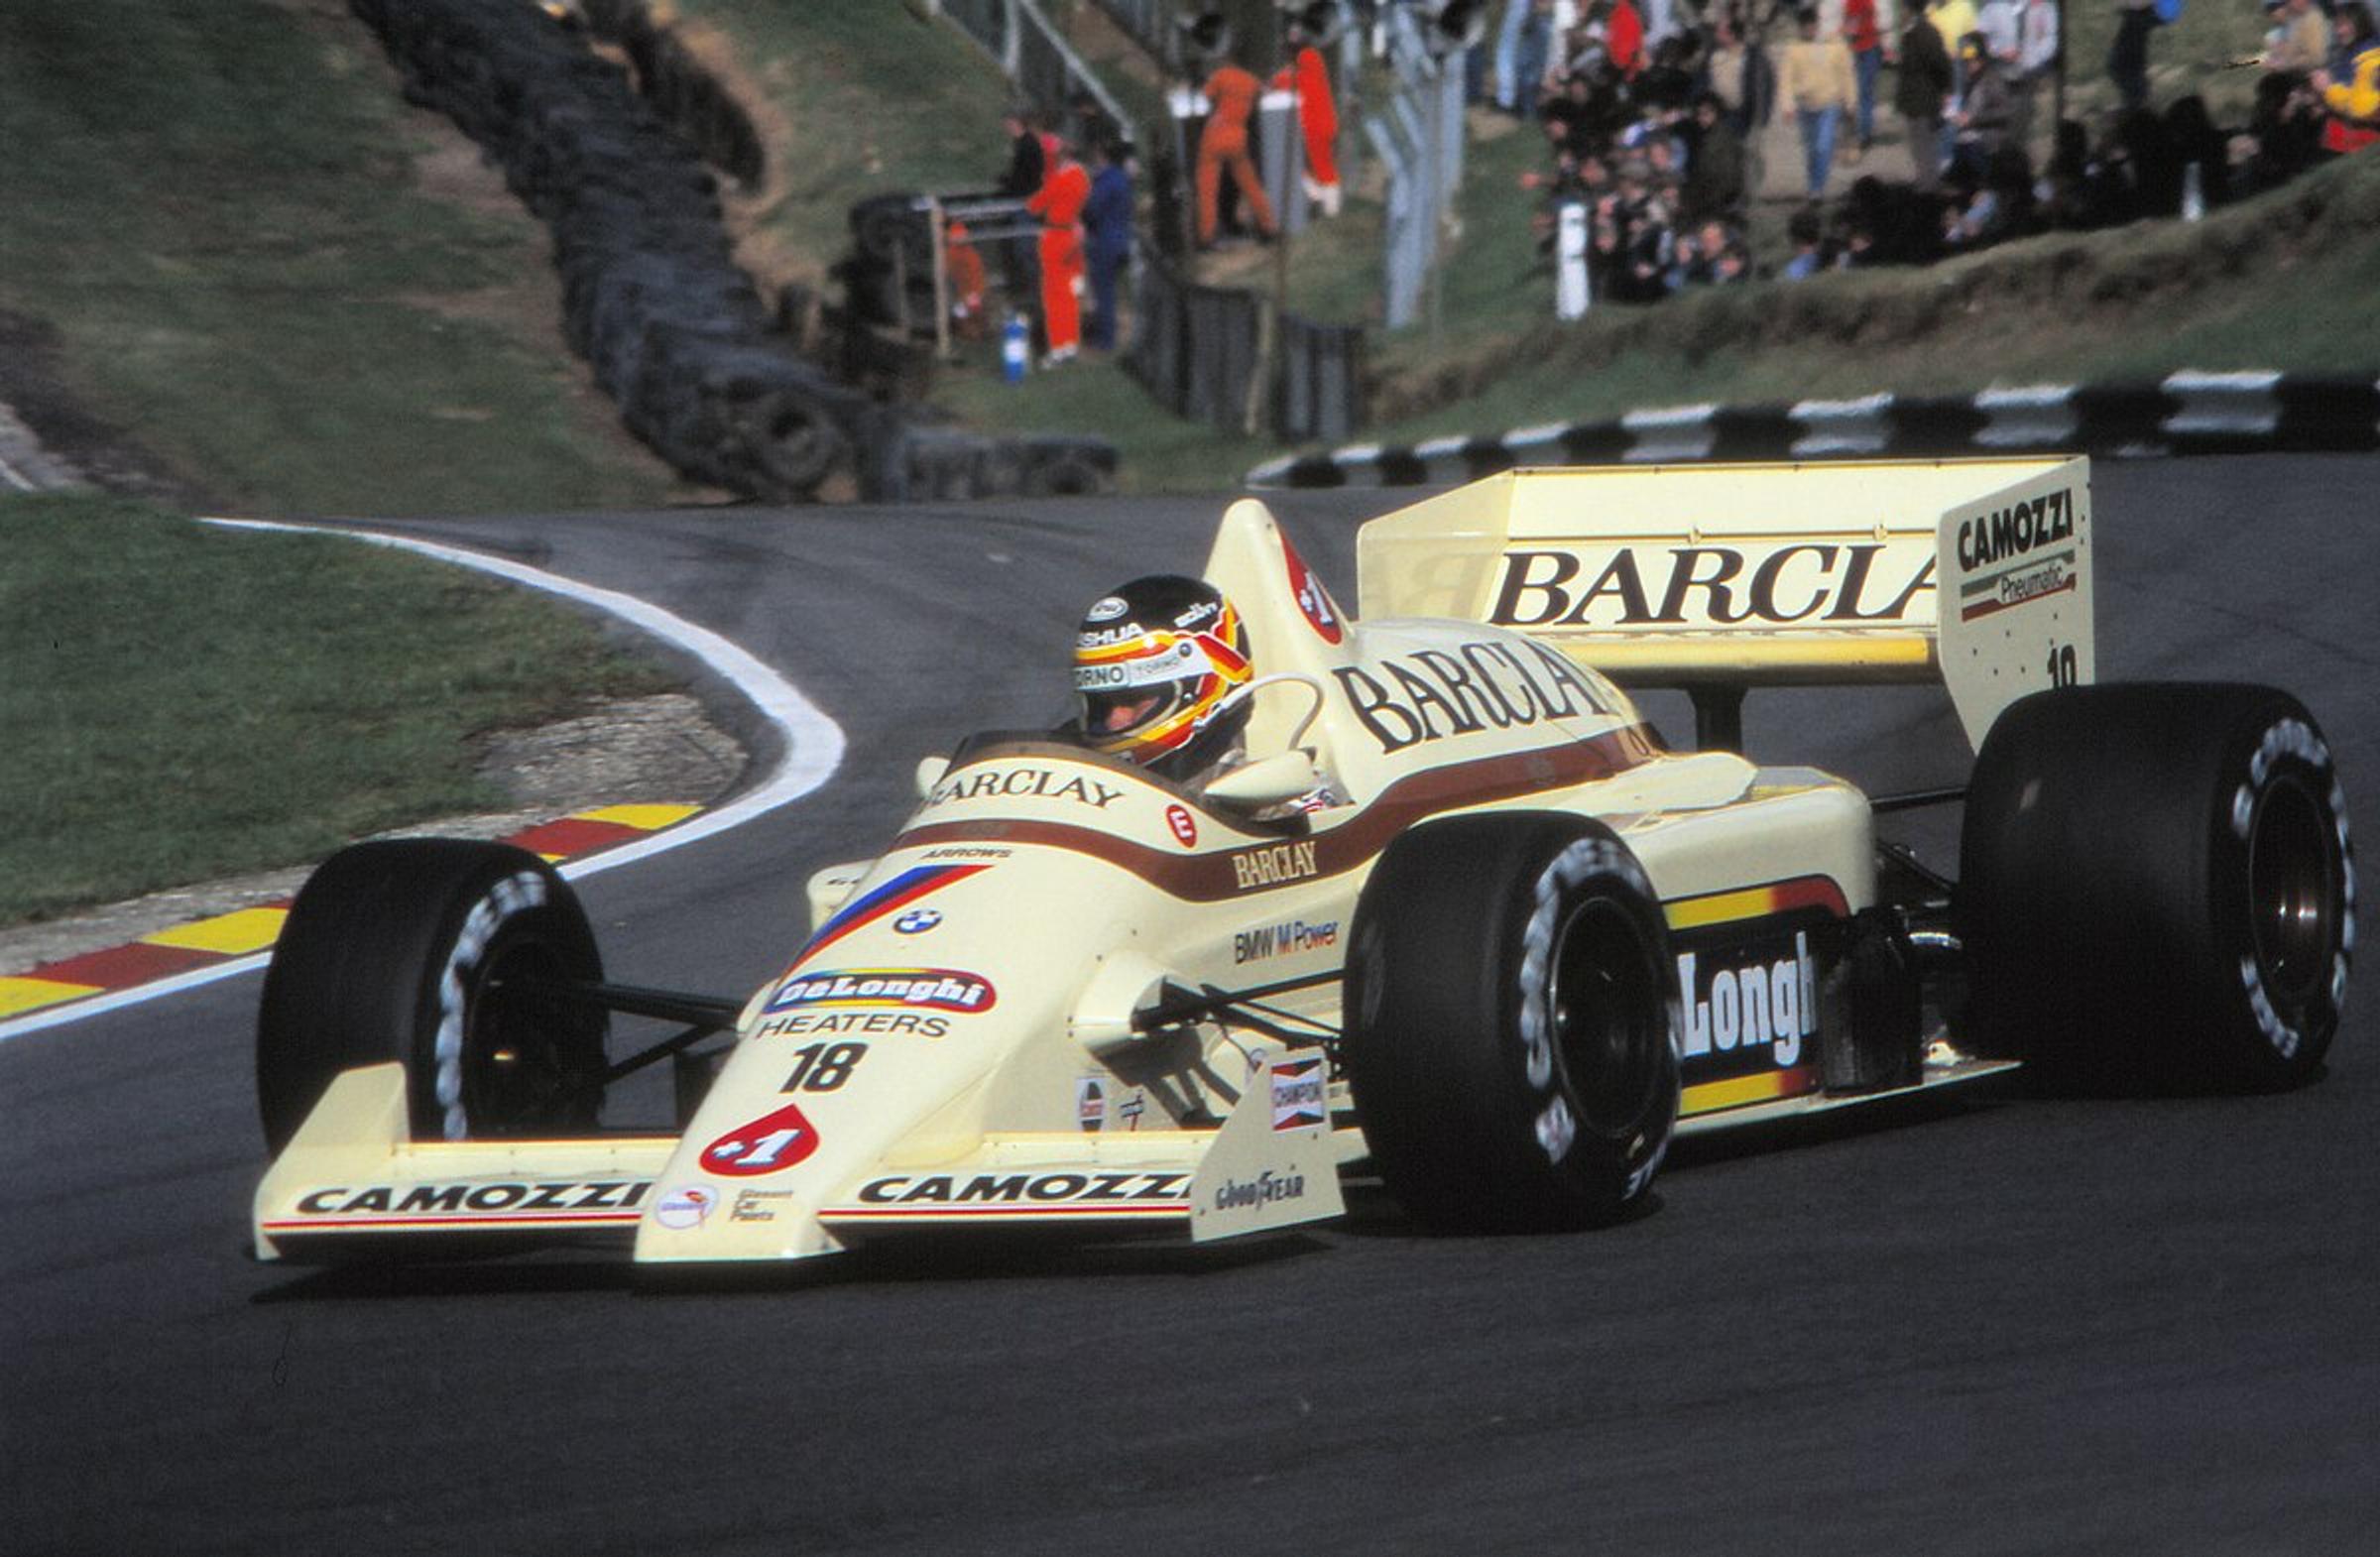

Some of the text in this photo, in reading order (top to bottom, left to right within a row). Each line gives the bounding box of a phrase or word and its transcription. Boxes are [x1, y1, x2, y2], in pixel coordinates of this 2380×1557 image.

[1959, 487, 2074, 573] CAMOZZI
[2001, 563, 2064, 602] Pneumatic
[1169, 809, 1192, 838] E
[920, 848, 1012, 859] ARROWS
[1232, 841, 1318, 889] BARCLAY
[1236, 926, 1275, 964] BMW
[1293, 920, 1339, 952] Power
[774, 977, 986, 1006] DeLonghi
[757, 1014, 951, 1037] HEATERS
[779, 1042, 869, 1094] 18
[713, 1129, 803, 1165] +1
[298, 1181, 653, 1213] CAMOZZI
